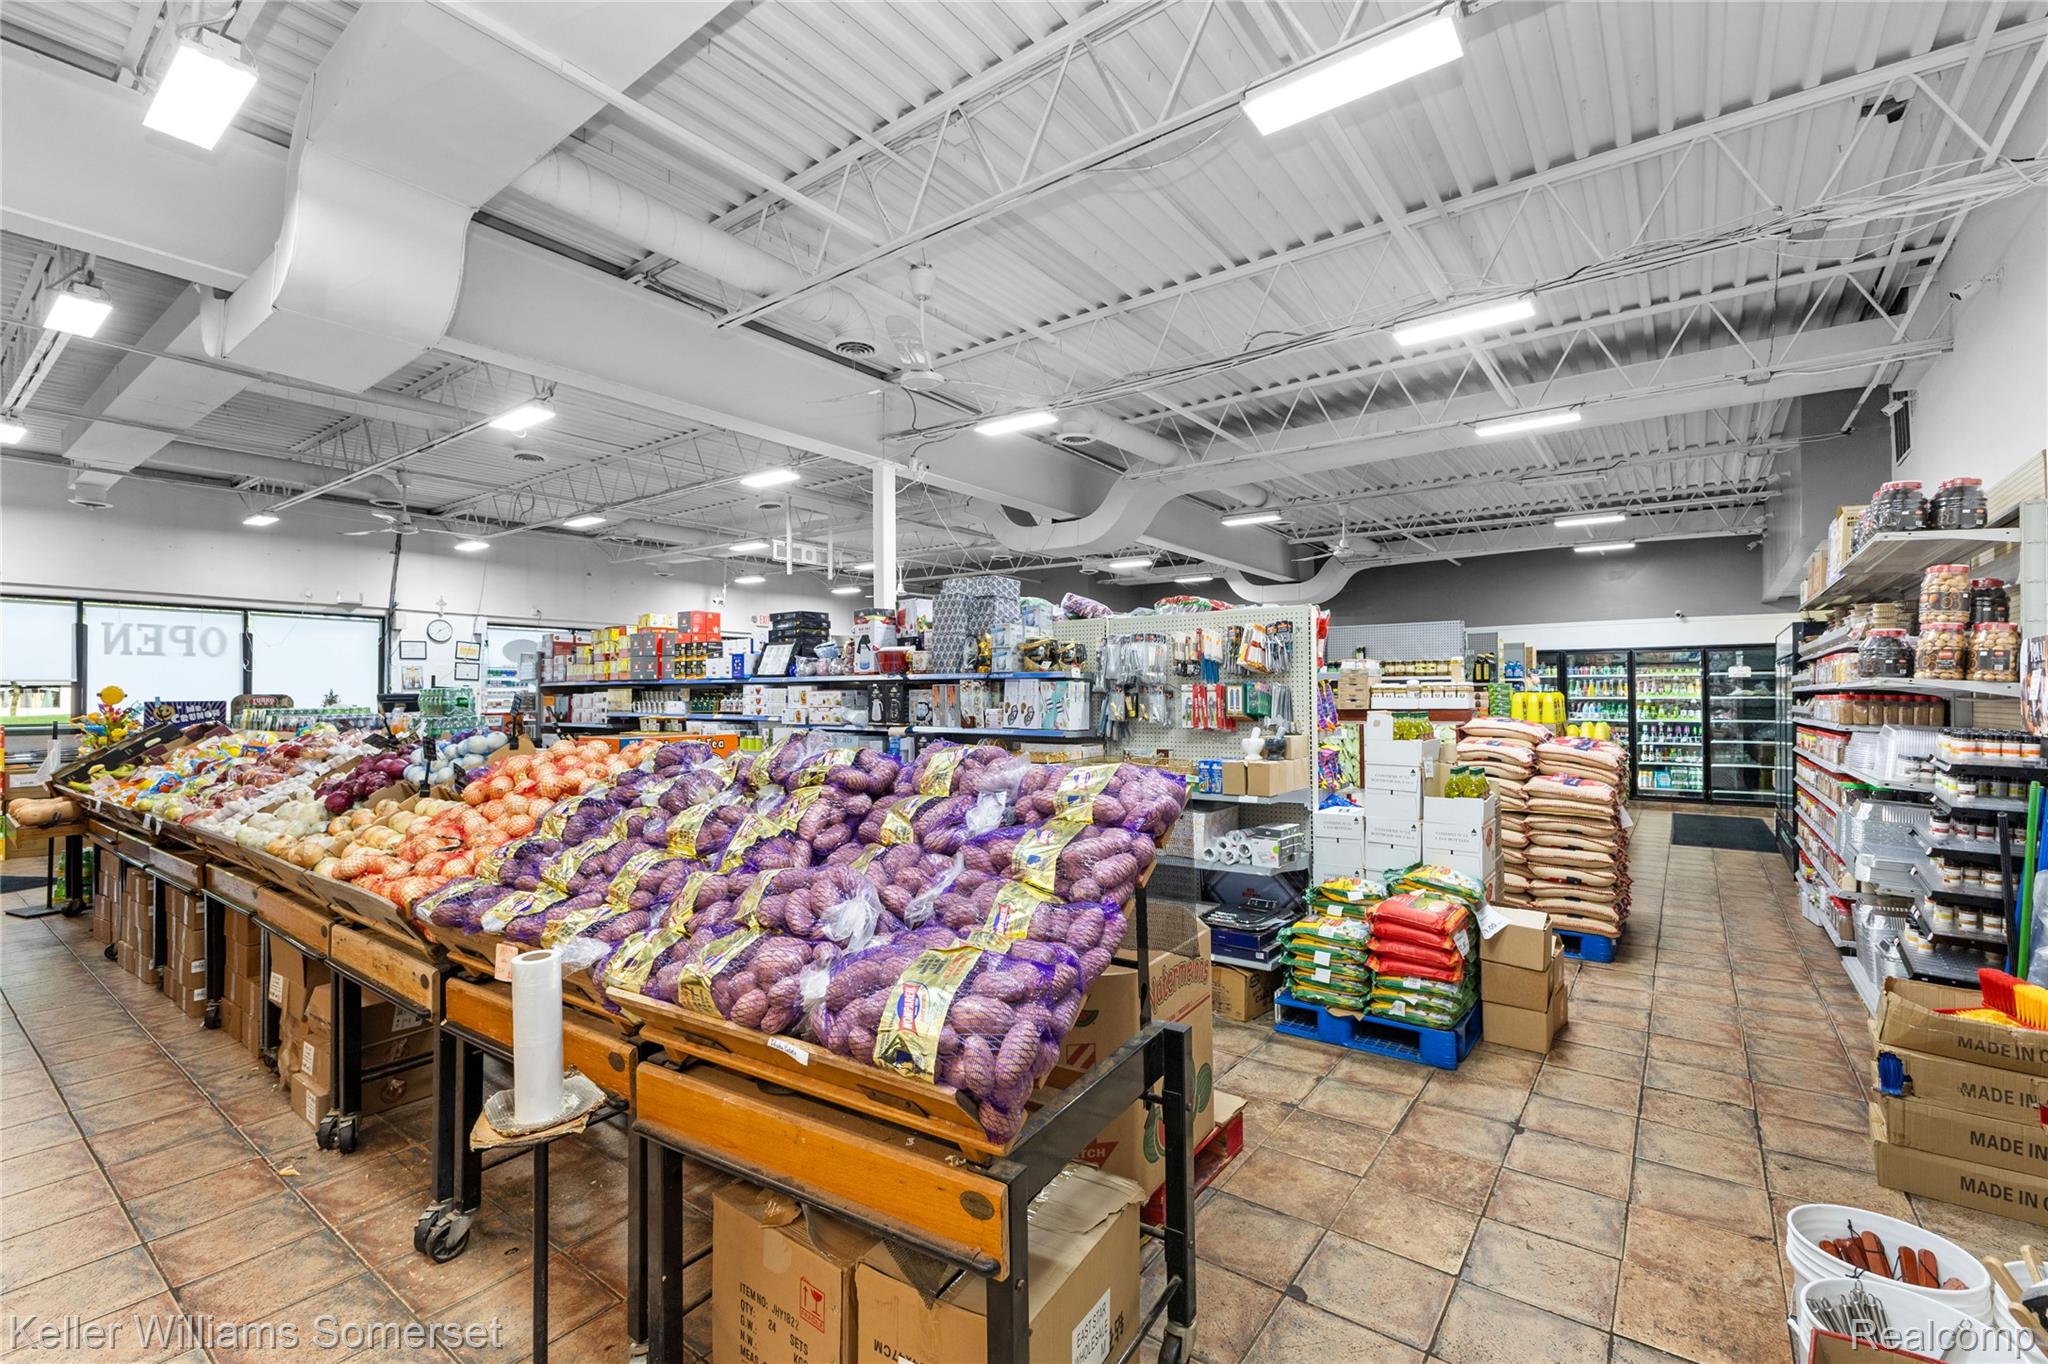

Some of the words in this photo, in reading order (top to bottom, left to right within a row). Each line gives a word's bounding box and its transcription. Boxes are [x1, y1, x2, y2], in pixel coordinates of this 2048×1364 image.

[1958, 1035, 2011, 1058] MADE
[2014, 1042, 2035, 1063] IN
[1960, 1082, 2015, 1106] MADE
[1970, 1130, 2024, 1156] MADE
[2028, 1143, 2048, 1162] IN
[1960, 1175, 2014, 1202] MADE
[2018, 1190, 2039, 1209] IN
[740, 1282, 756, 1302] ITEM
[756, 1295, 769, 1310] NO:
[740, 1299, 756, 1318] QTY:
[767, 1319, 777, 1333] 24
[789, 1333, 809, 1356] SETS
